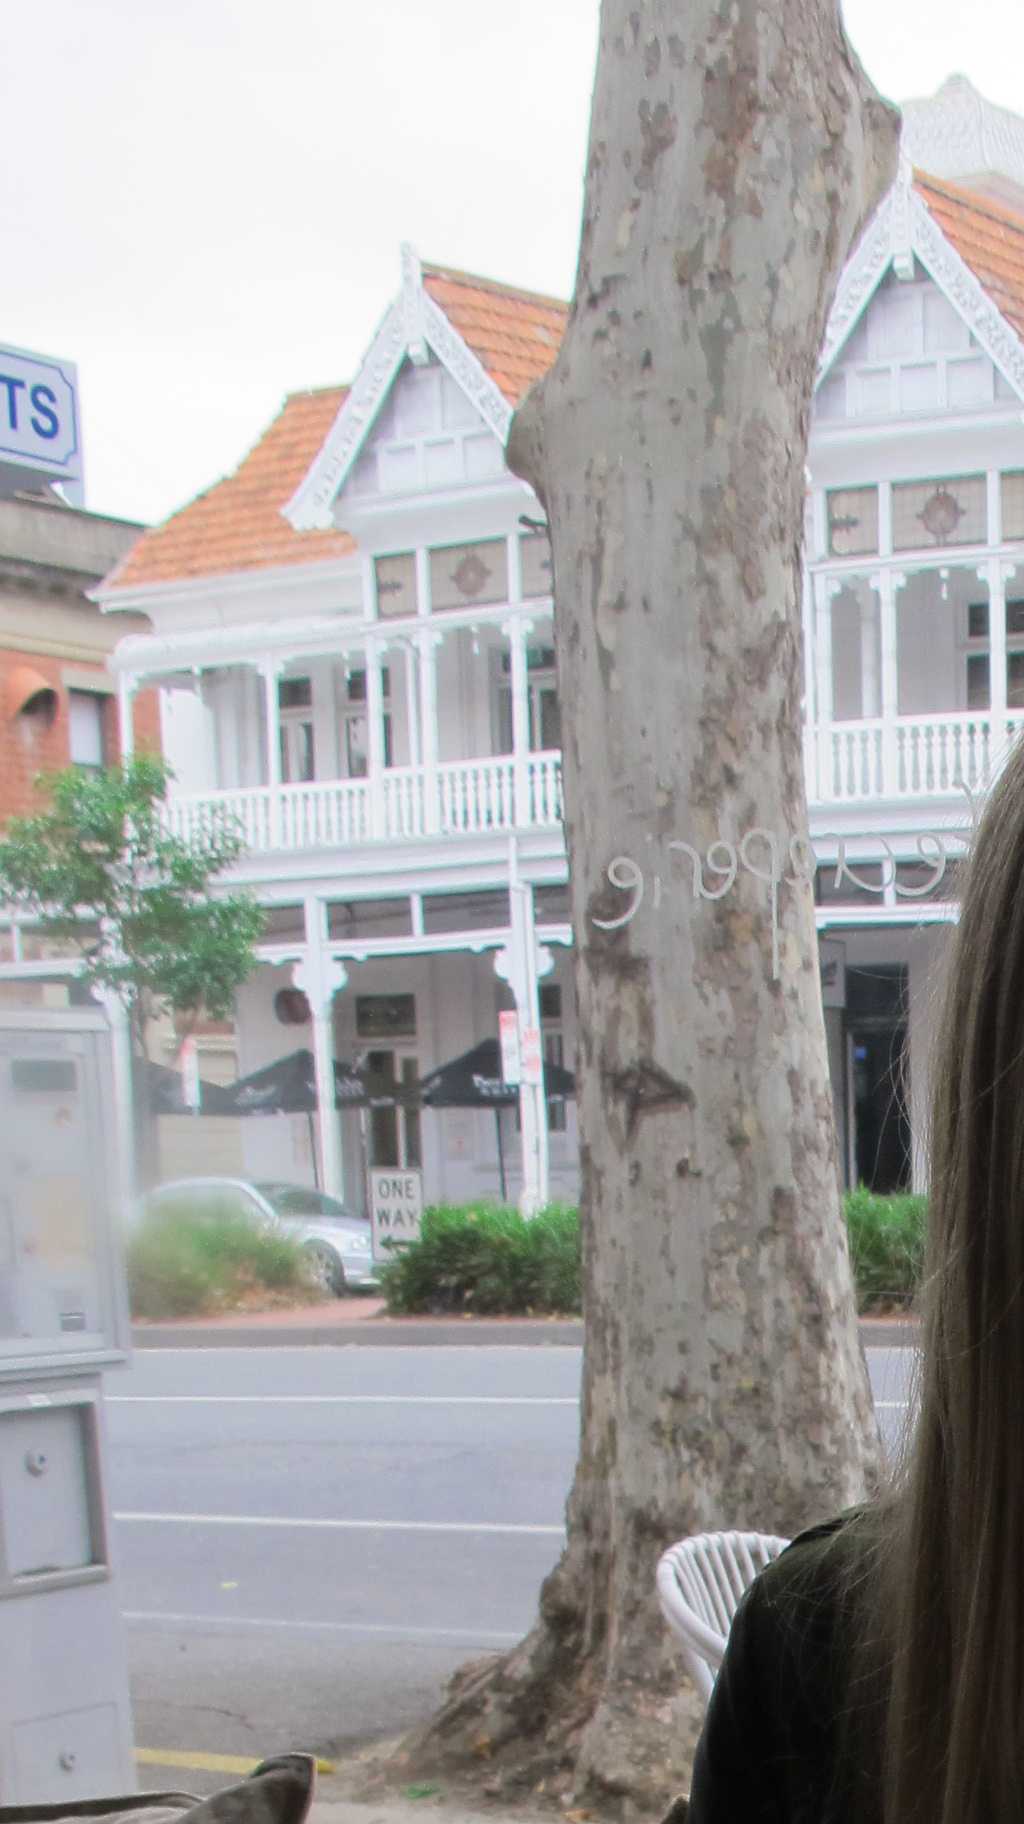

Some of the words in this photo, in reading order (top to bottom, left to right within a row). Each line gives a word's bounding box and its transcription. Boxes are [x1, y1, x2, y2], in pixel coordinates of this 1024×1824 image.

[0, 373, 60, 440] TS
[378, 1178, 415, 1199] ONE
[376, 1206, 418, 1227] WAY
